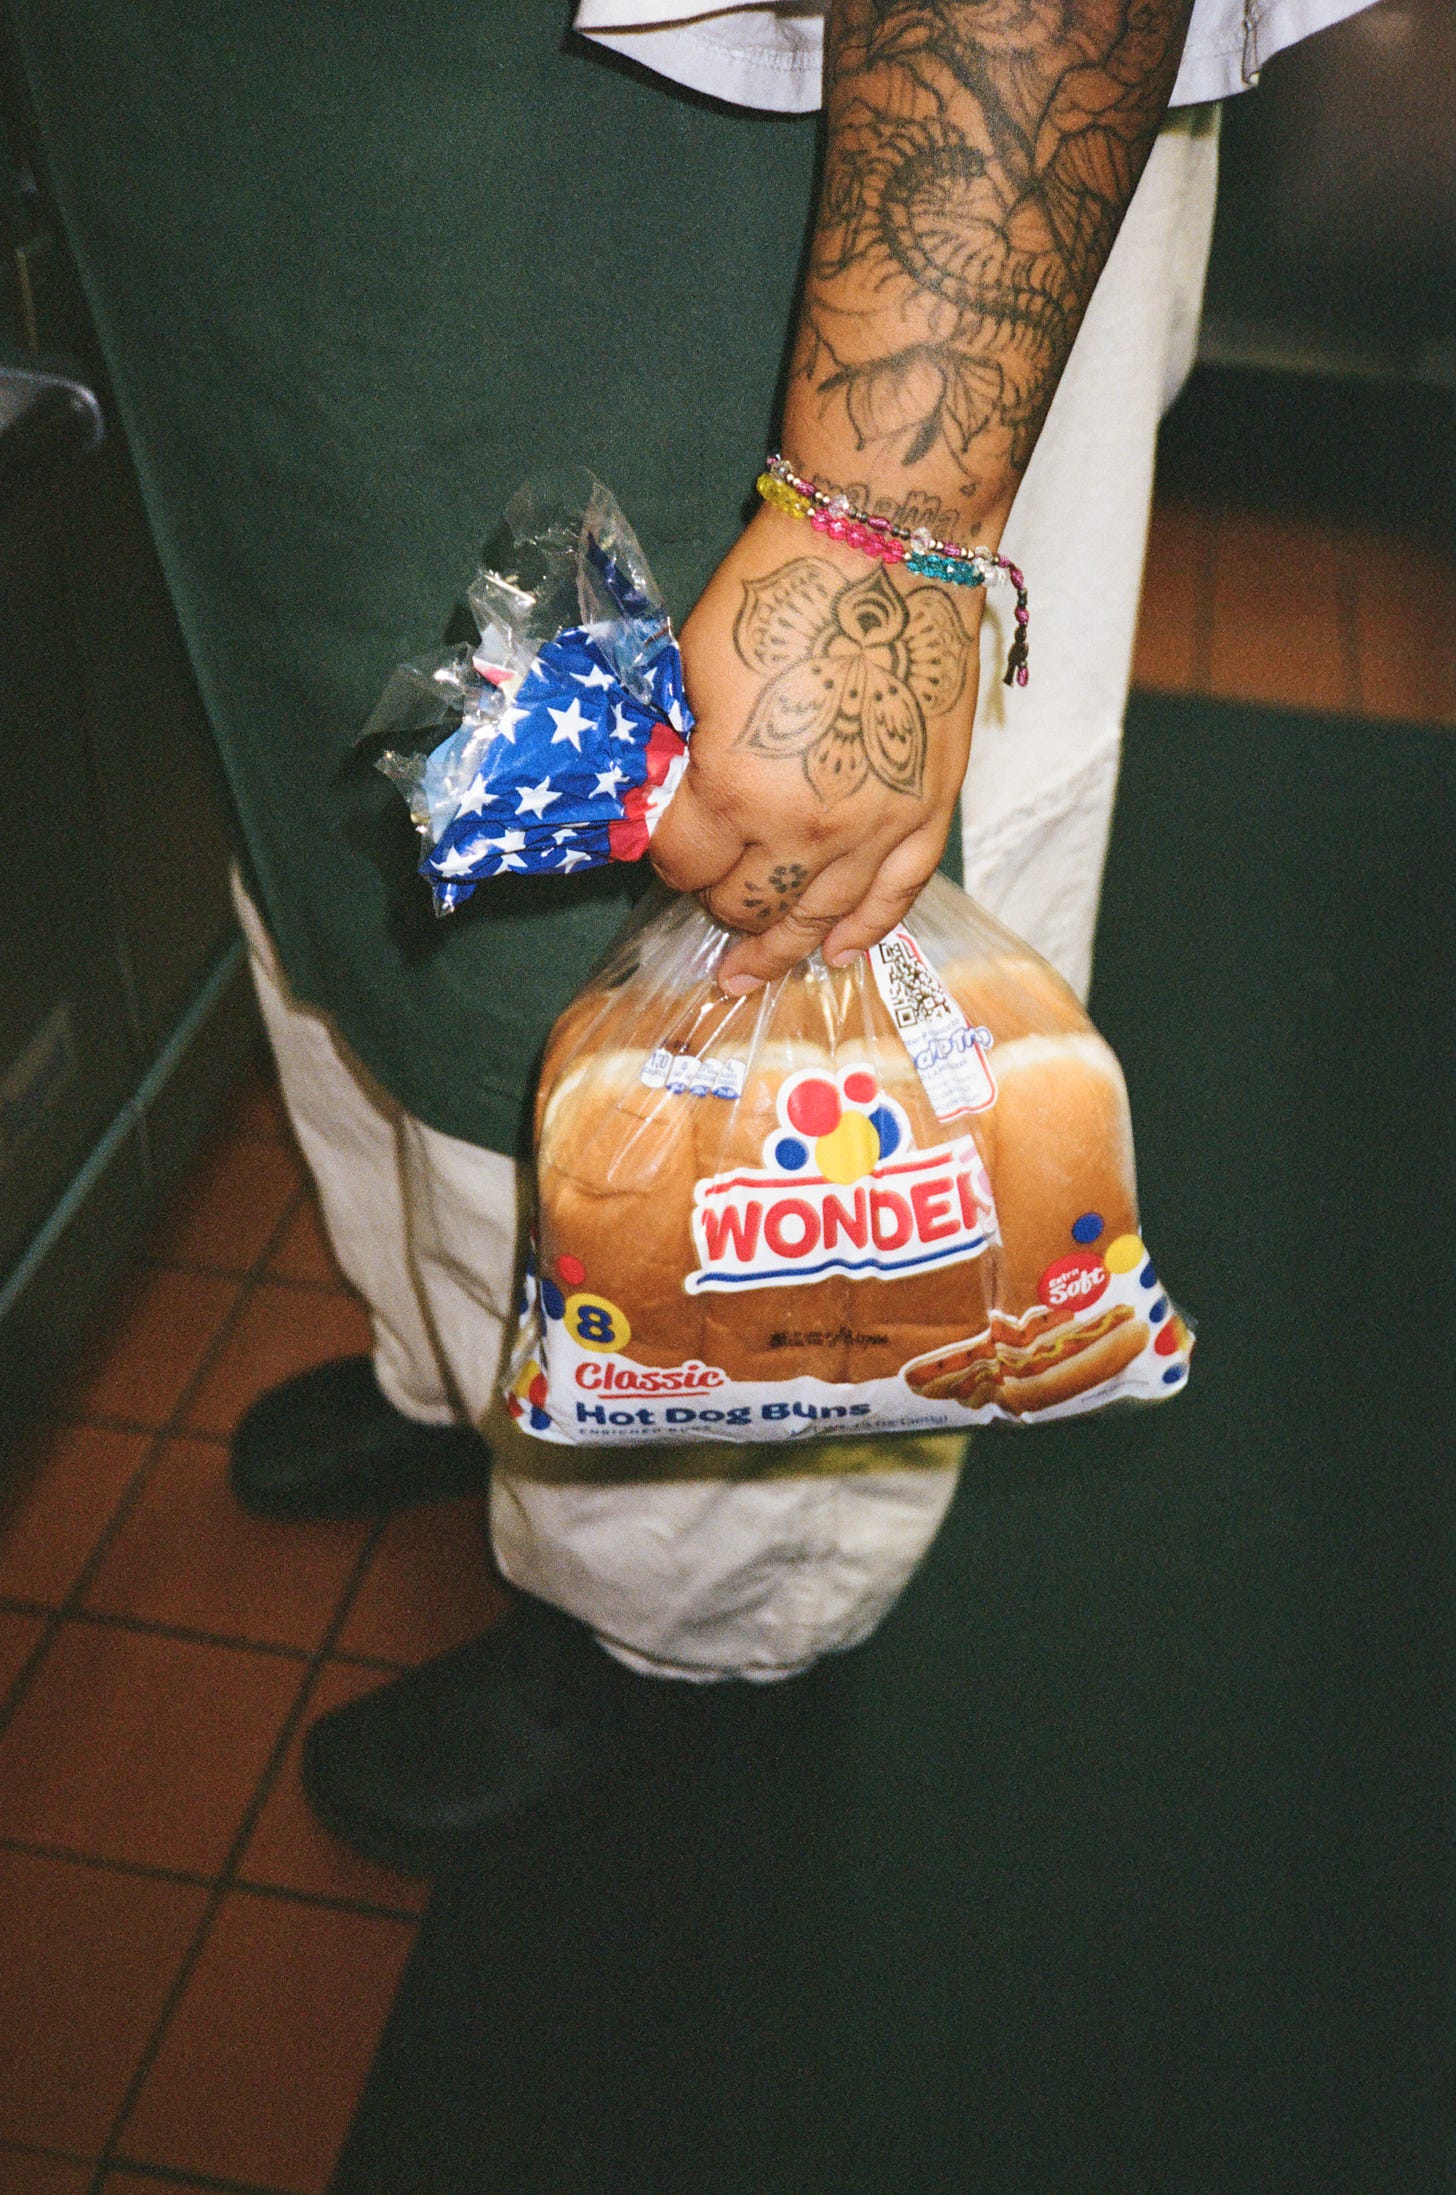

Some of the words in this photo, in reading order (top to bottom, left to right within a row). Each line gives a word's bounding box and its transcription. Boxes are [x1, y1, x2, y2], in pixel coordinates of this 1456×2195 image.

[1048, 1267, 1080, 1289] Extra
[1049, 1267, 1105, 1305] Soft
[577, 1305, 615, 1344] 8
[575, 1361, 725, 1391] Classic
[576, 1401, 656, 1425] Hot
[665, 1406, 751, 1426] Dog
[761, 1401, 871, 1420] Buns
